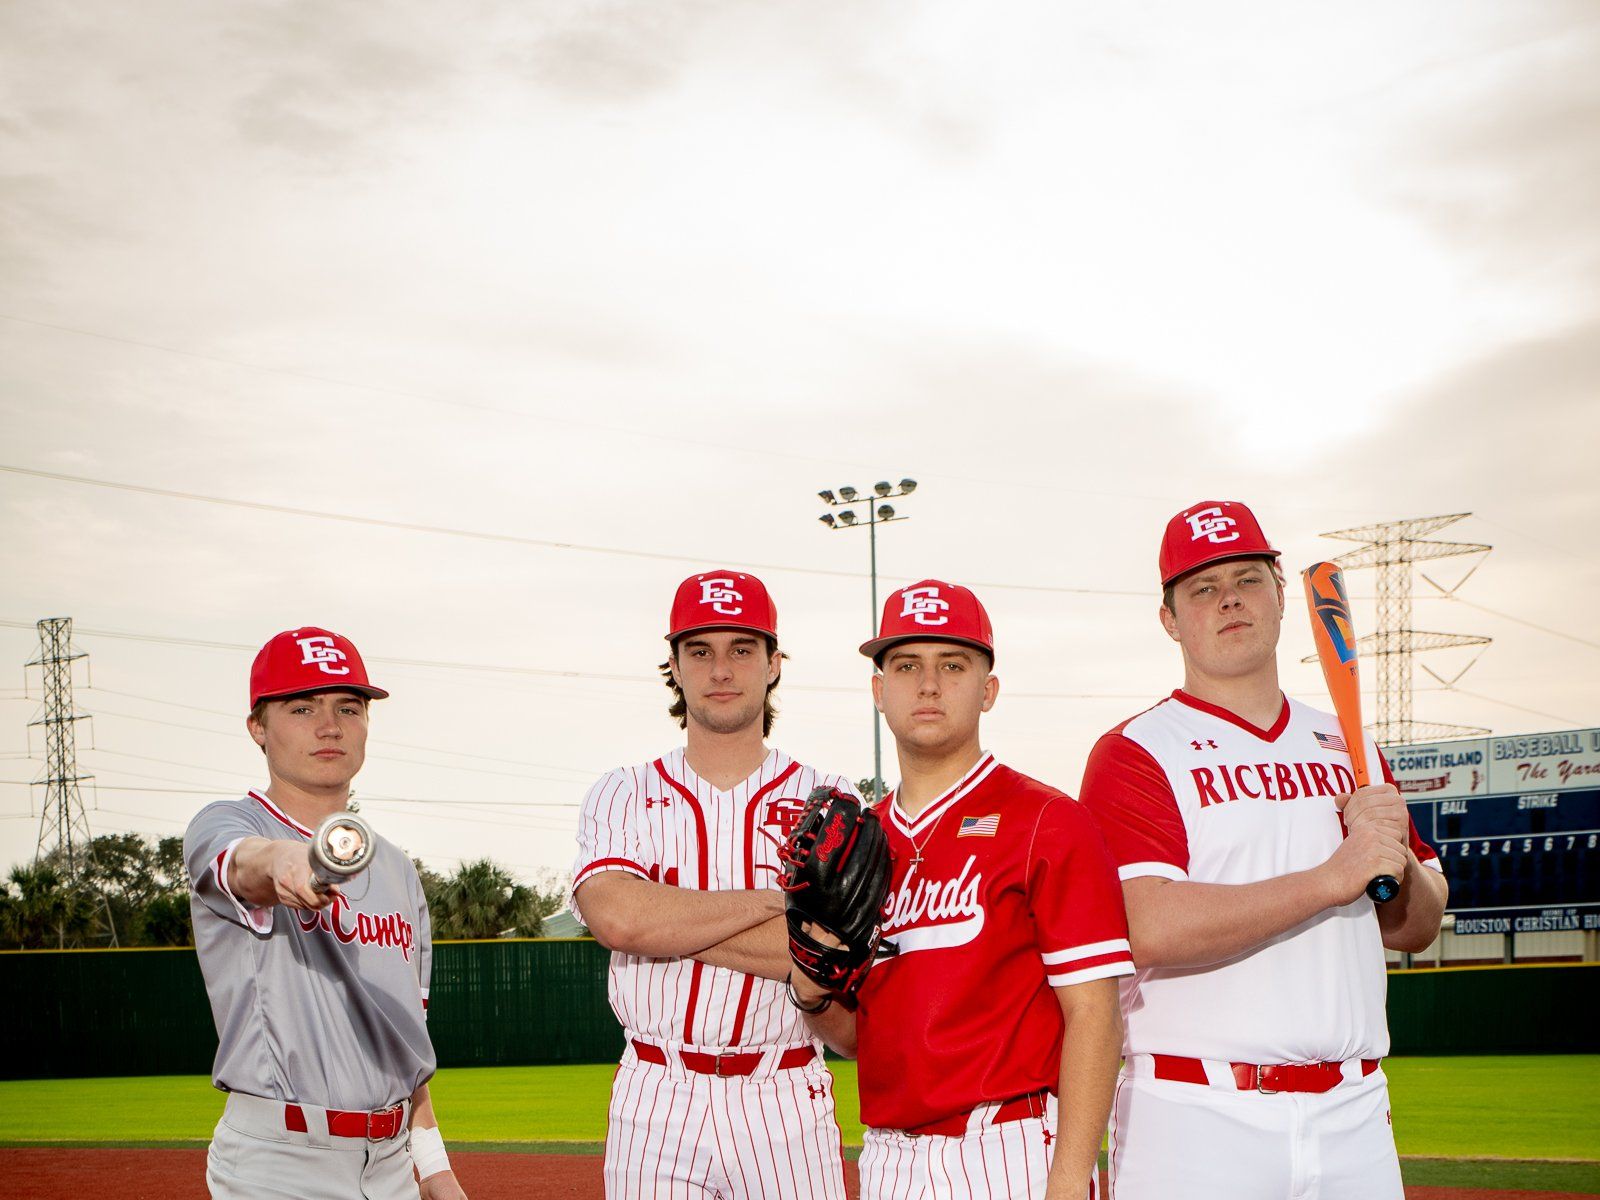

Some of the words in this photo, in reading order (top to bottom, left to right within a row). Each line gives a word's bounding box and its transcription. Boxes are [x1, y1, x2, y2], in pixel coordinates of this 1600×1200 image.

[1186, 506, 1240, 544] EC
[699, 578, 742, 616] EC
[900, 586, 949, 626] EC
[297, 636, 349, 675] EC
[1495, 733, 1584, 761] BASEBALL
[1398, 755, 1438, 771] CONEY
[1440, 750, 1483, 768] ISLAND
[1517, 762, 1548, 781] The
[1441, 801, 1468, 815] BALL
[1517, 793, 1559, 810] STRIKE
[1440, 844, 1448, 858] 1
[1460, 842, 1470, 857] 2
[1481, 841, 1491, 855] 3
[1502, 840, 1511, 854] 4
[1523, 838, 1533, 852] 5
[1544, 837, 1554, 851] 6
[1566, 836, 1575, 850] 7
[1587, 834, 1597, 848] 8
[1456, 918, 1511, 934] HOUSTON
[1514, 915, 1580, 932] CHRISTIAN
